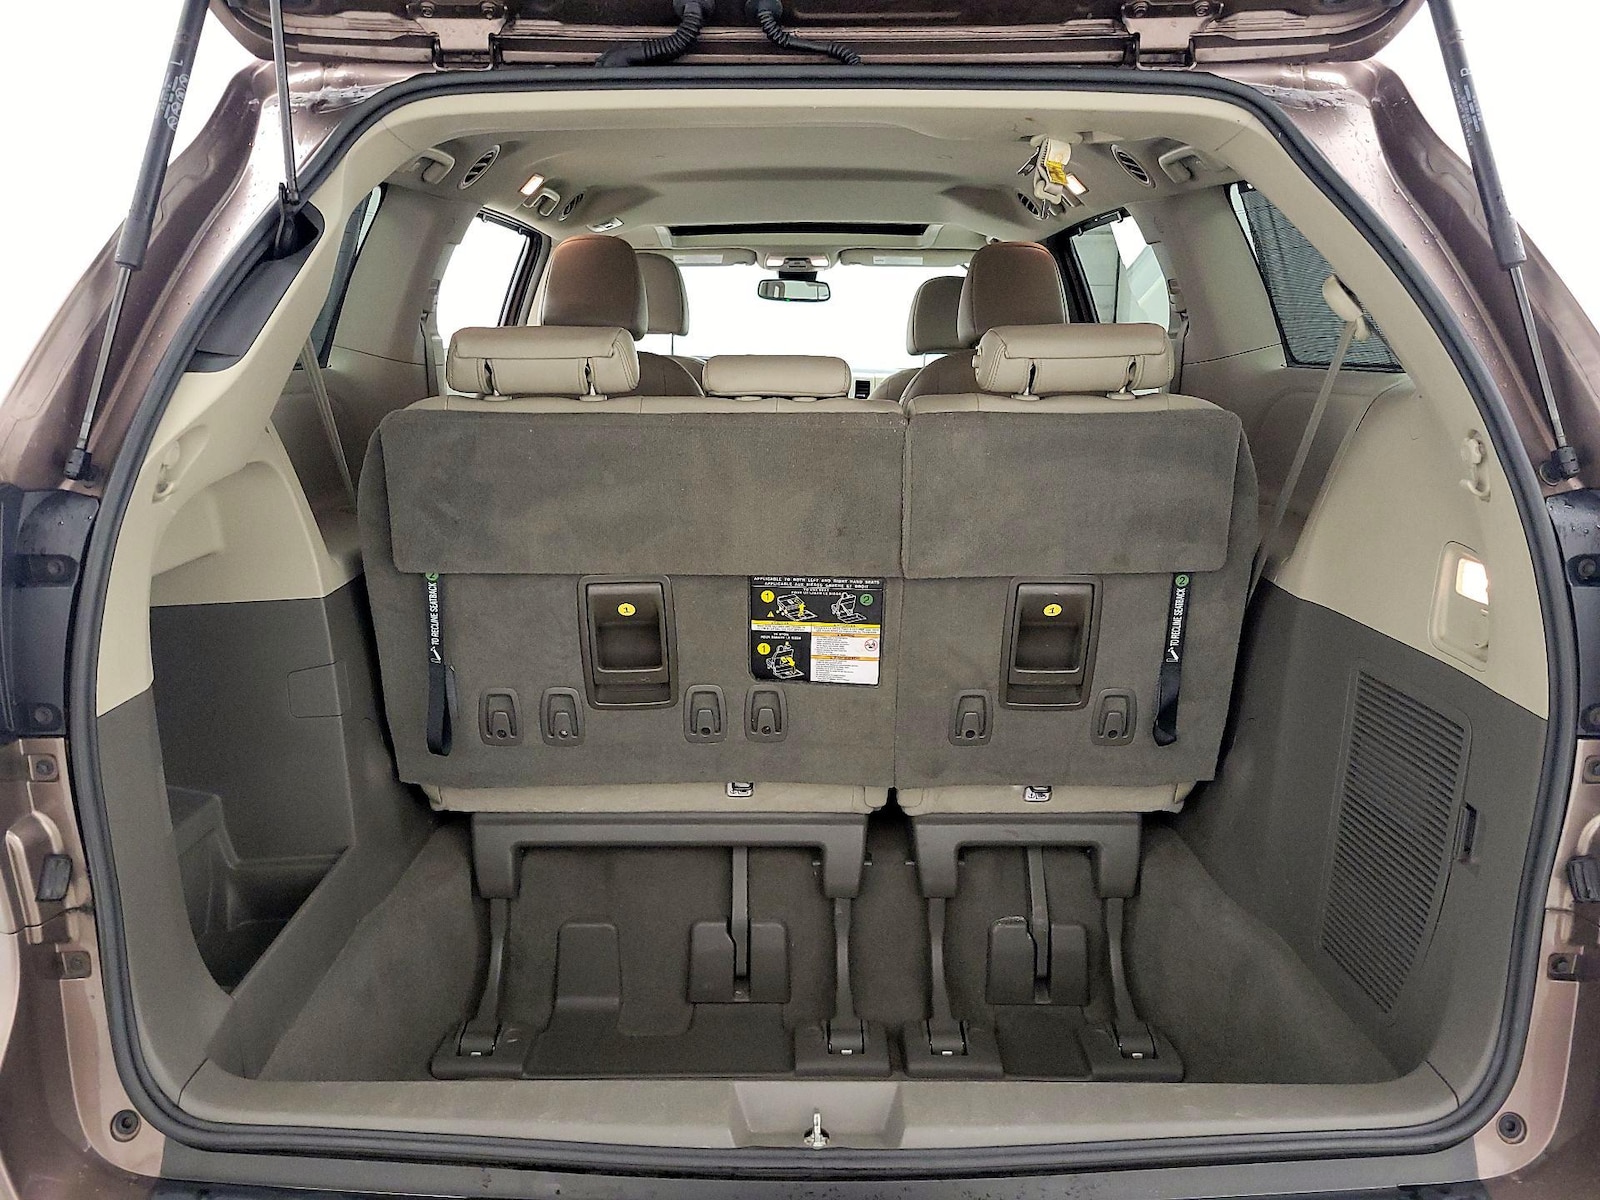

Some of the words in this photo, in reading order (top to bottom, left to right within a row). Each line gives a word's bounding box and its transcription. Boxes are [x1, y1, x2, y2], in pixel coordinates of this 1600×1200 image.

[427, 581, 439, 613] SEATBACK
[1173, 587, 1186, 616] SEATBACK
[430, 612, 440, 638] RECLINE
[1170, 616, 1183, 639] RECLINE
[431, 637, 440, 646] TO
[1169, 639, 1180, 647] TO
